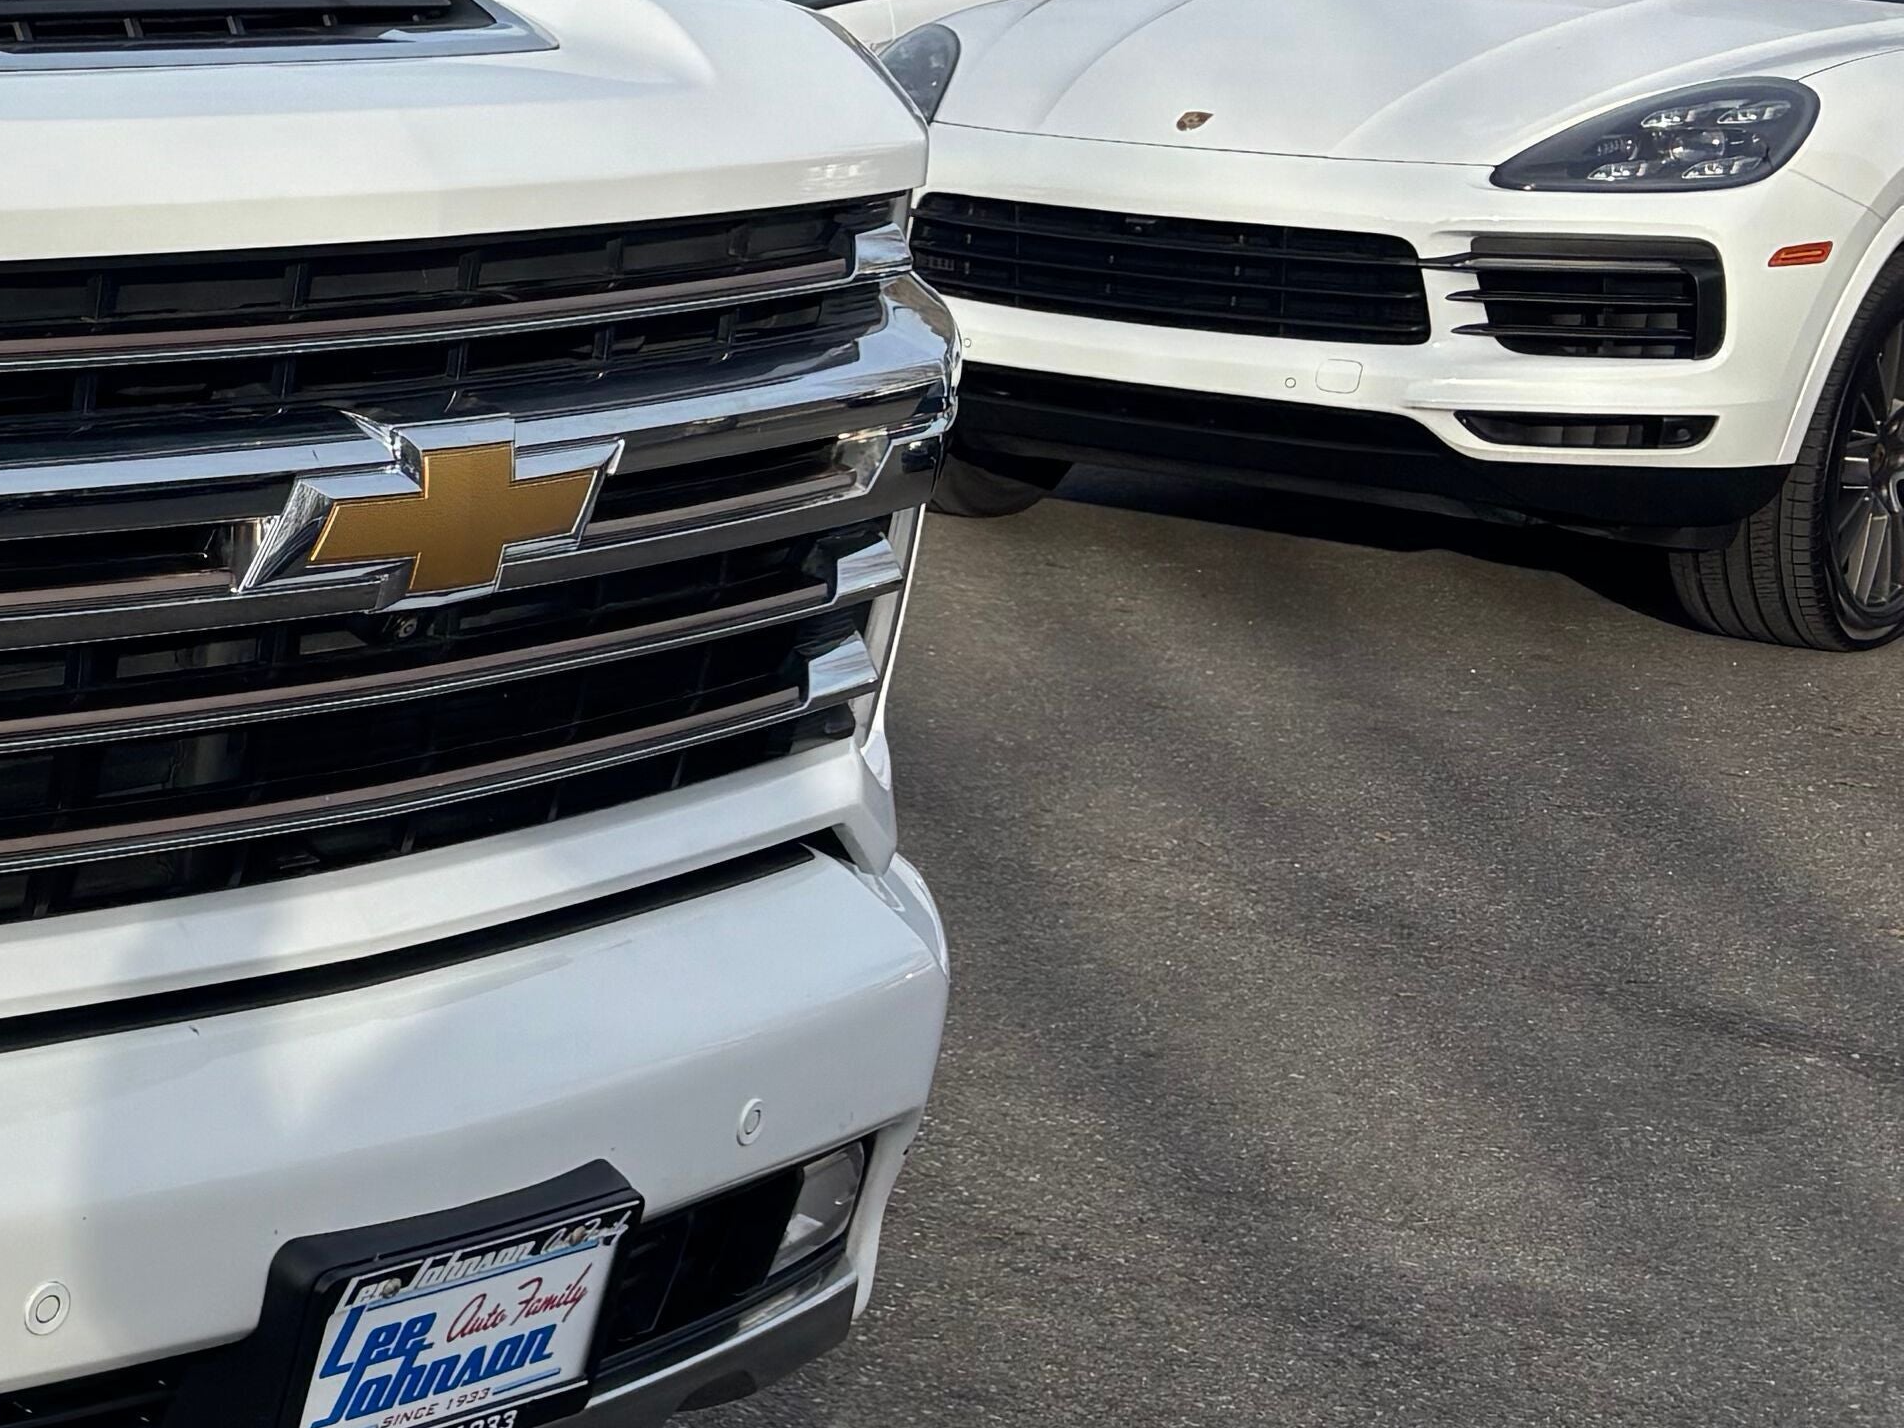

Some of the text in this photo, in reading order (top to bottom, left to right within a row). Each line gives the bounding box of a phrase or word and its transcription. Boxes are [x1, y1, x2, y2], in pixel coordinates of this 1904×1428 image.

[408, 1241, 535, 1291] Johnson
[446, 1262, 593, 1344] Auto Family
[319, 1303, 437, 1379] Lee
[446, 1387, 491, 1411] 1933
